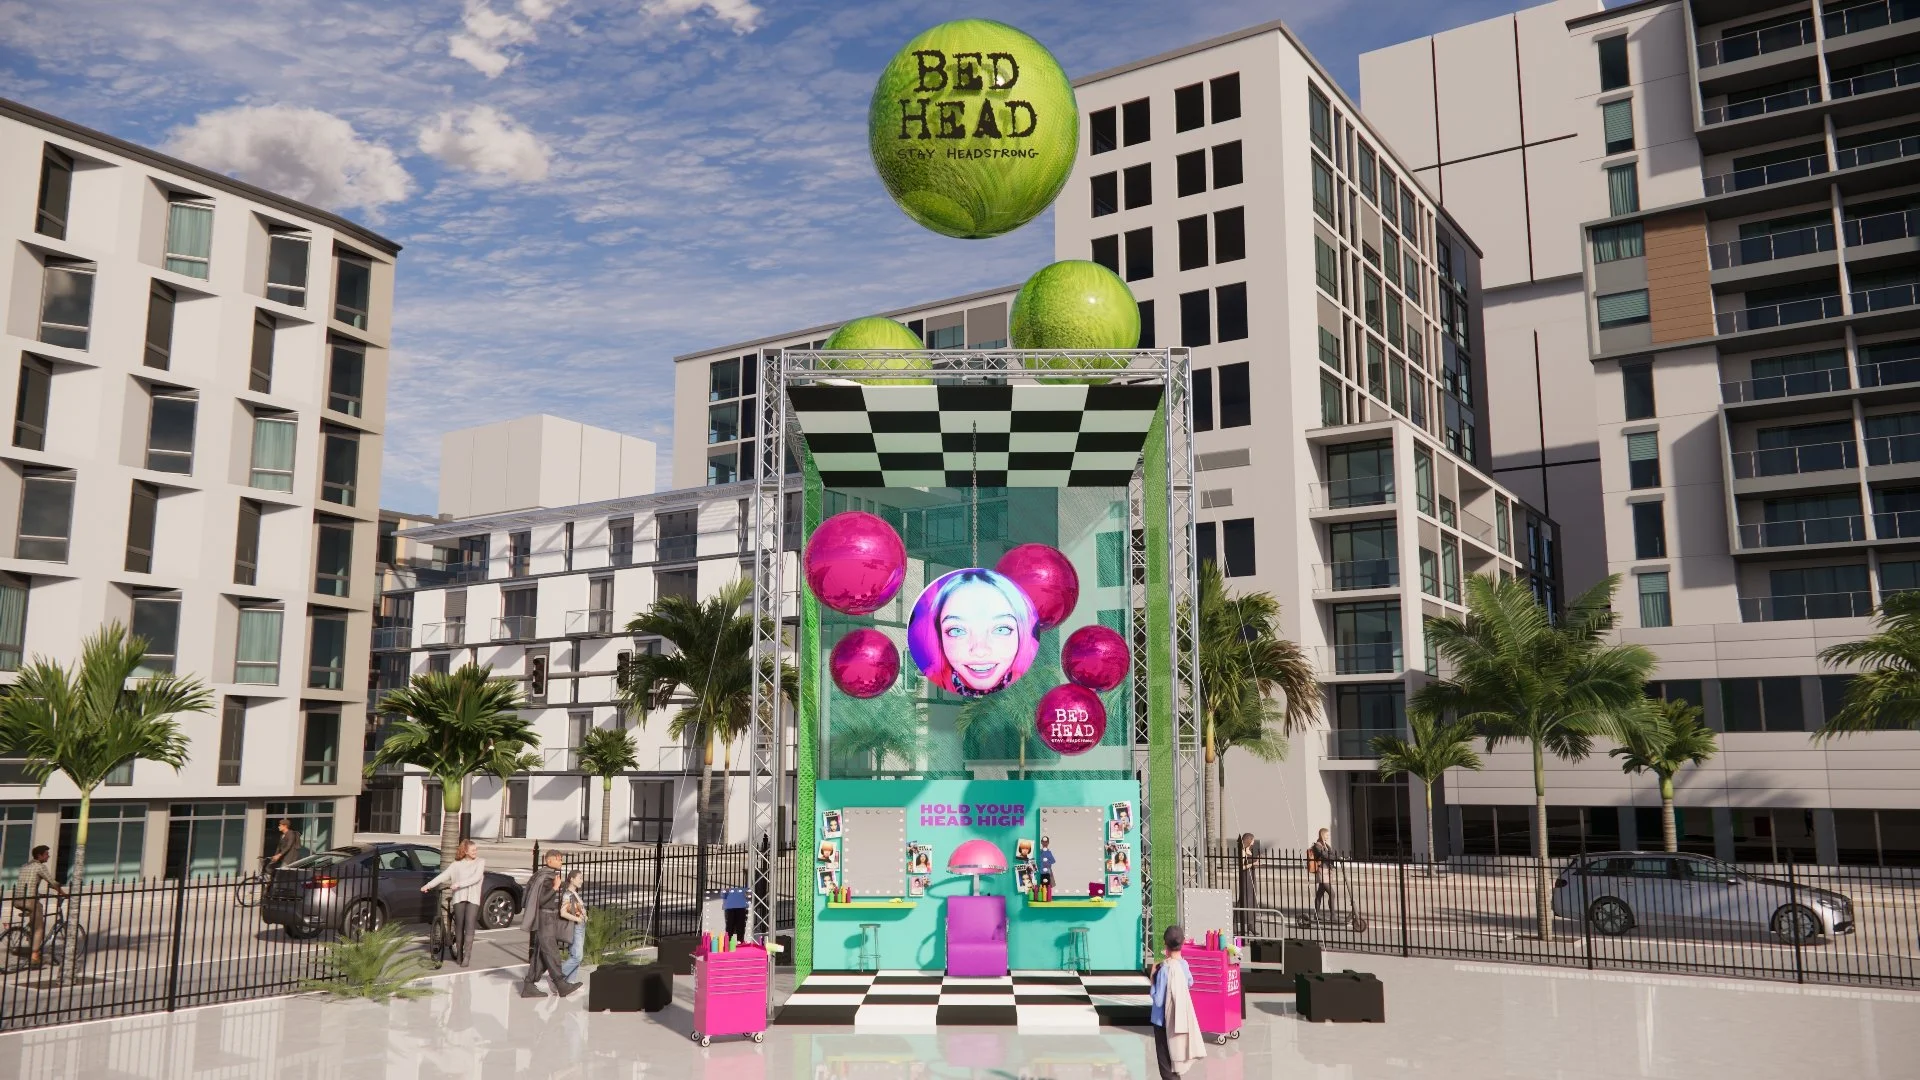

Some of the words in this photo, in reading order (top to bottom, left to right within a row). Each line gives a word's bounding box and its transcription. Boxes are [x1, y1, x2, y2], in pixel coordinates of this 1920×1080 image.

[912, 50, 1019, 92] BED
[898, 98, 1038, 139] HEAD
[898, 148, 935, 159] STAY
[947, 148, 1039, 160] HEADSTRONG
[1055, 708, 1089, 723] BED
[1051, 723, 1095, 737] HEAD
[920, 804, 970, 814] HOLD
[975, 804, 1025, 814] YOUR
[920, 815, 972, 826] HEAD
[977, 815, 1025, 826] HIGH
